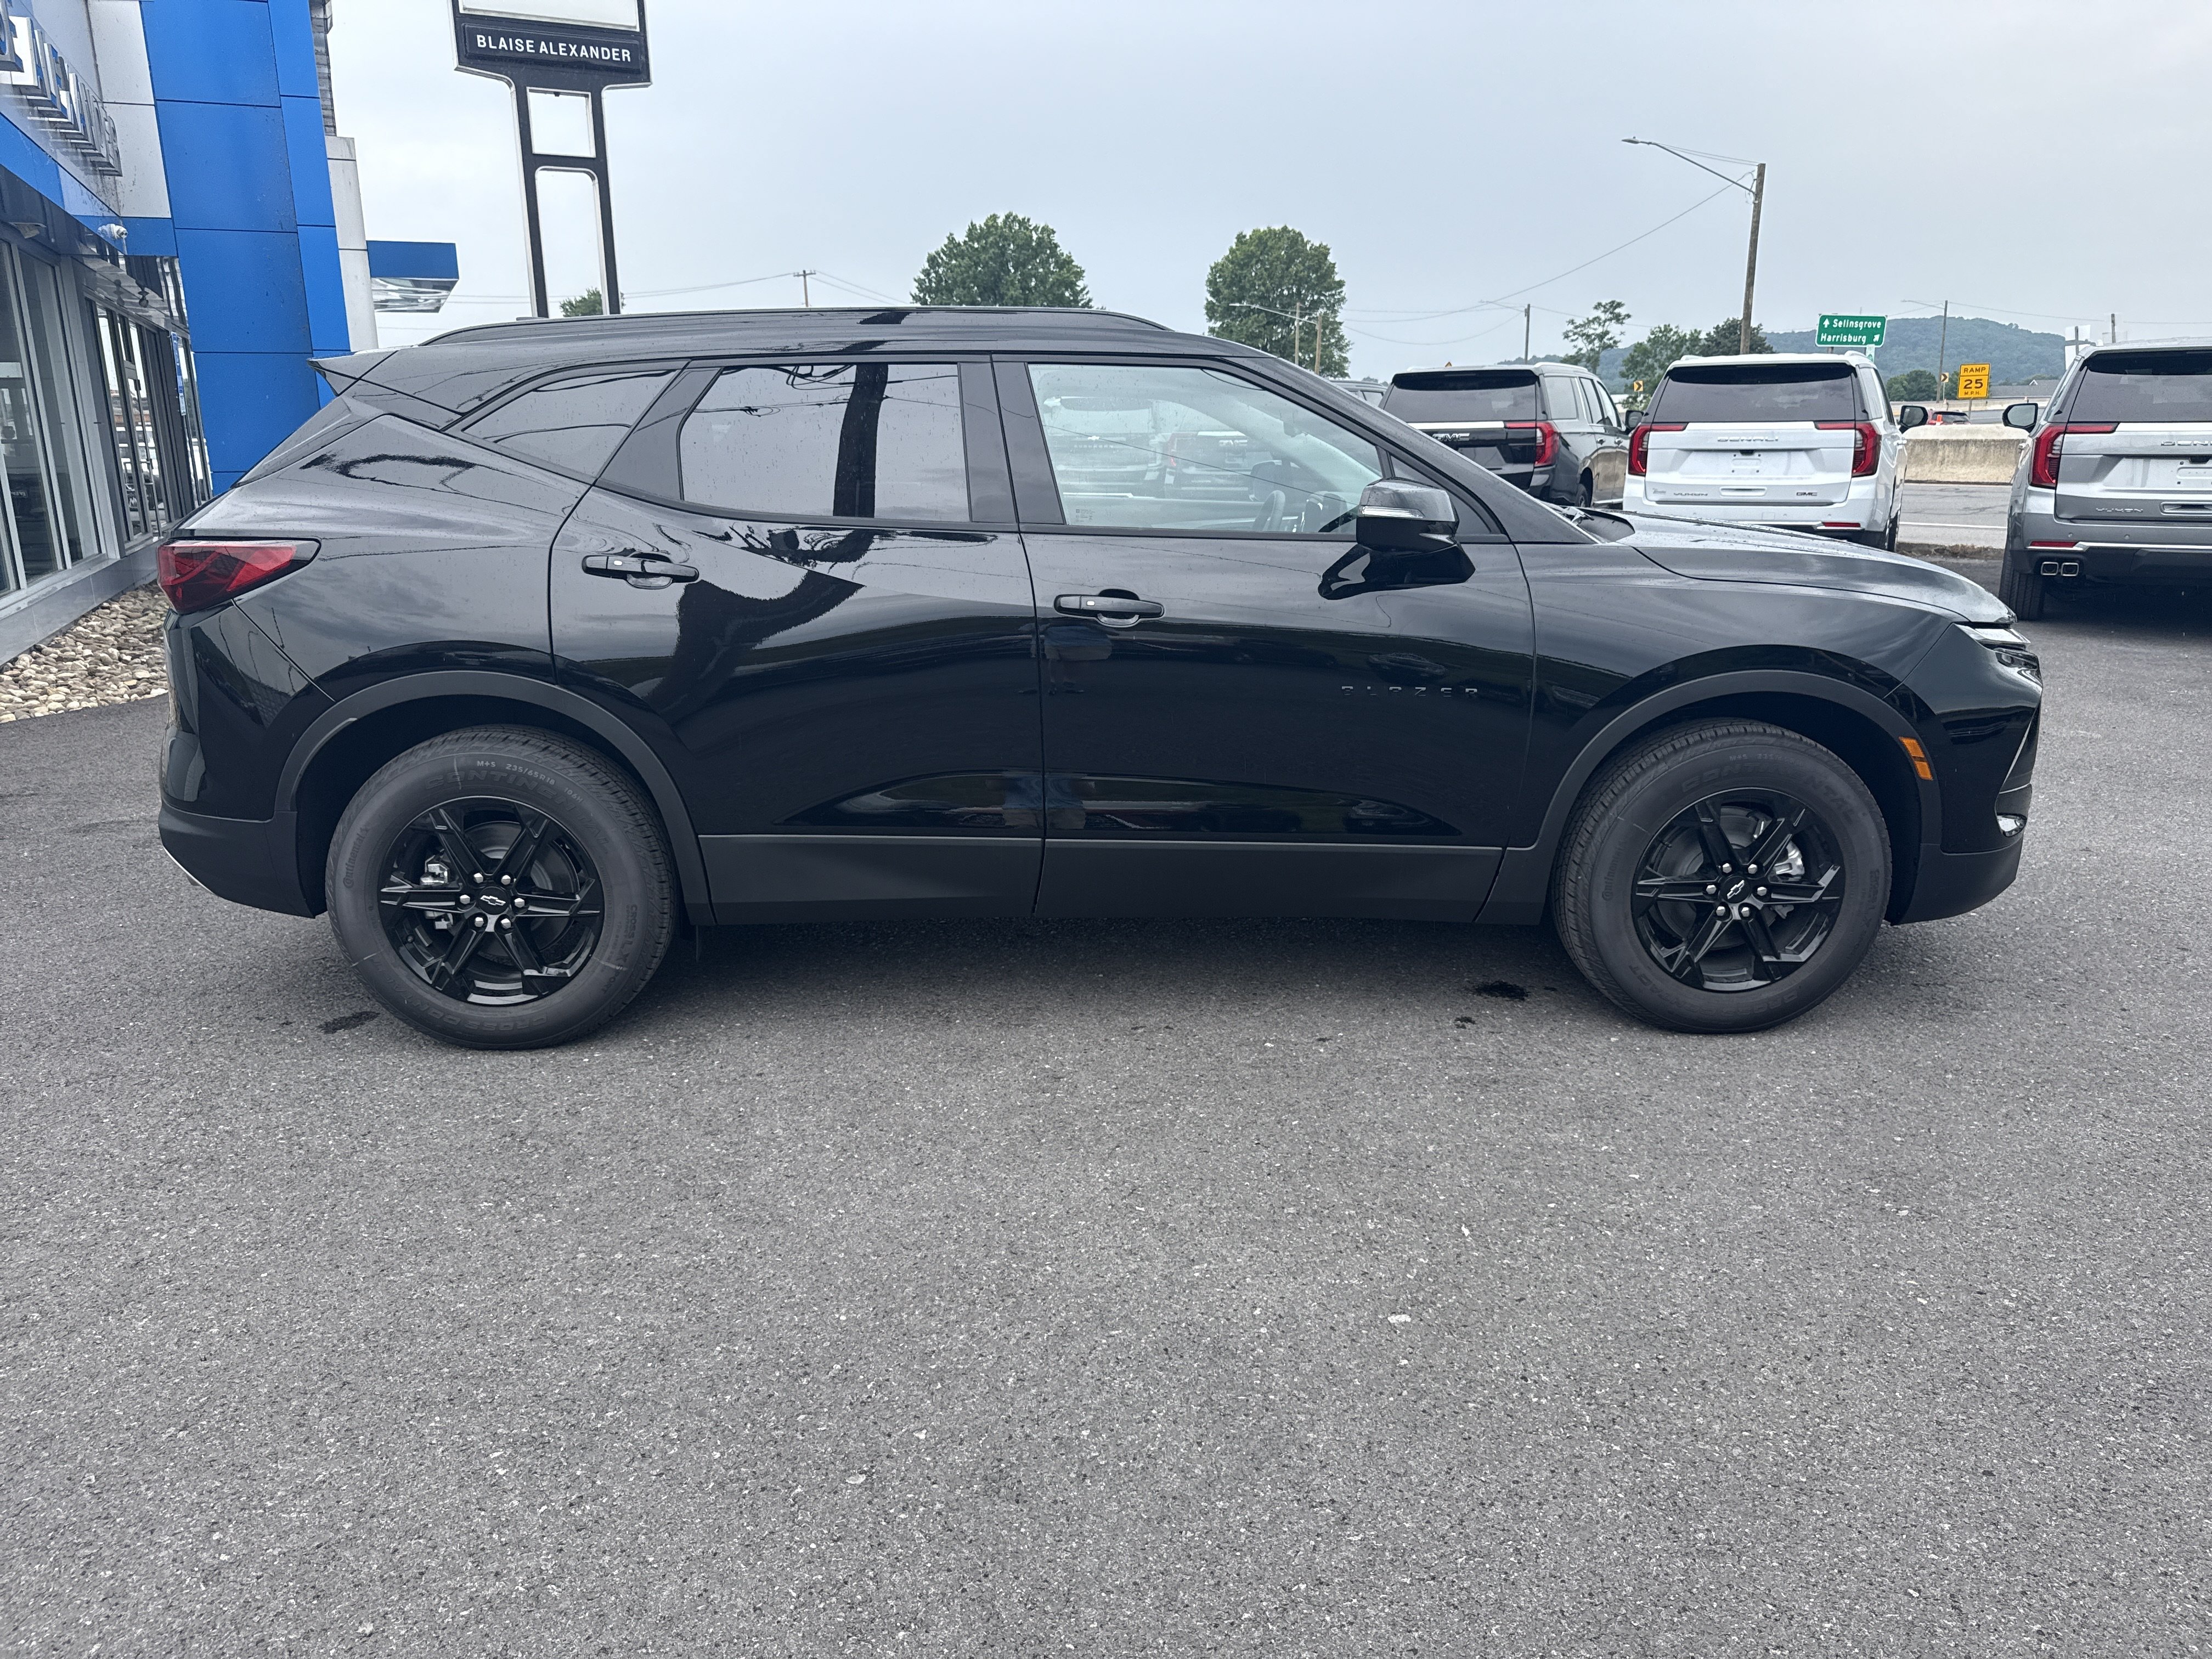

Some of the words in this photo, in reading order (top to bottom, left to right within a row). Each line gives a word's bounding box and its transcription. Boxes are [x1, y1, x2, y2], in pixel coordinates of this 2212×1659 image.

[476, 34, 535, 53] BLAISE
[539, 41, 631, 62] ALEXANDER
[1832, 319, 1882, 330] Selinsgrove
[1820, 332, 1866, 345] Harrisburg
[1963, 379, 1983, 389] 25
[1432, 433, 1470, 442] GMC
[1341, 686, 1477, 697] BLAZER
[505, 763, 556, 786] 235/65R18
[564, 787, 584, 803] 106H
